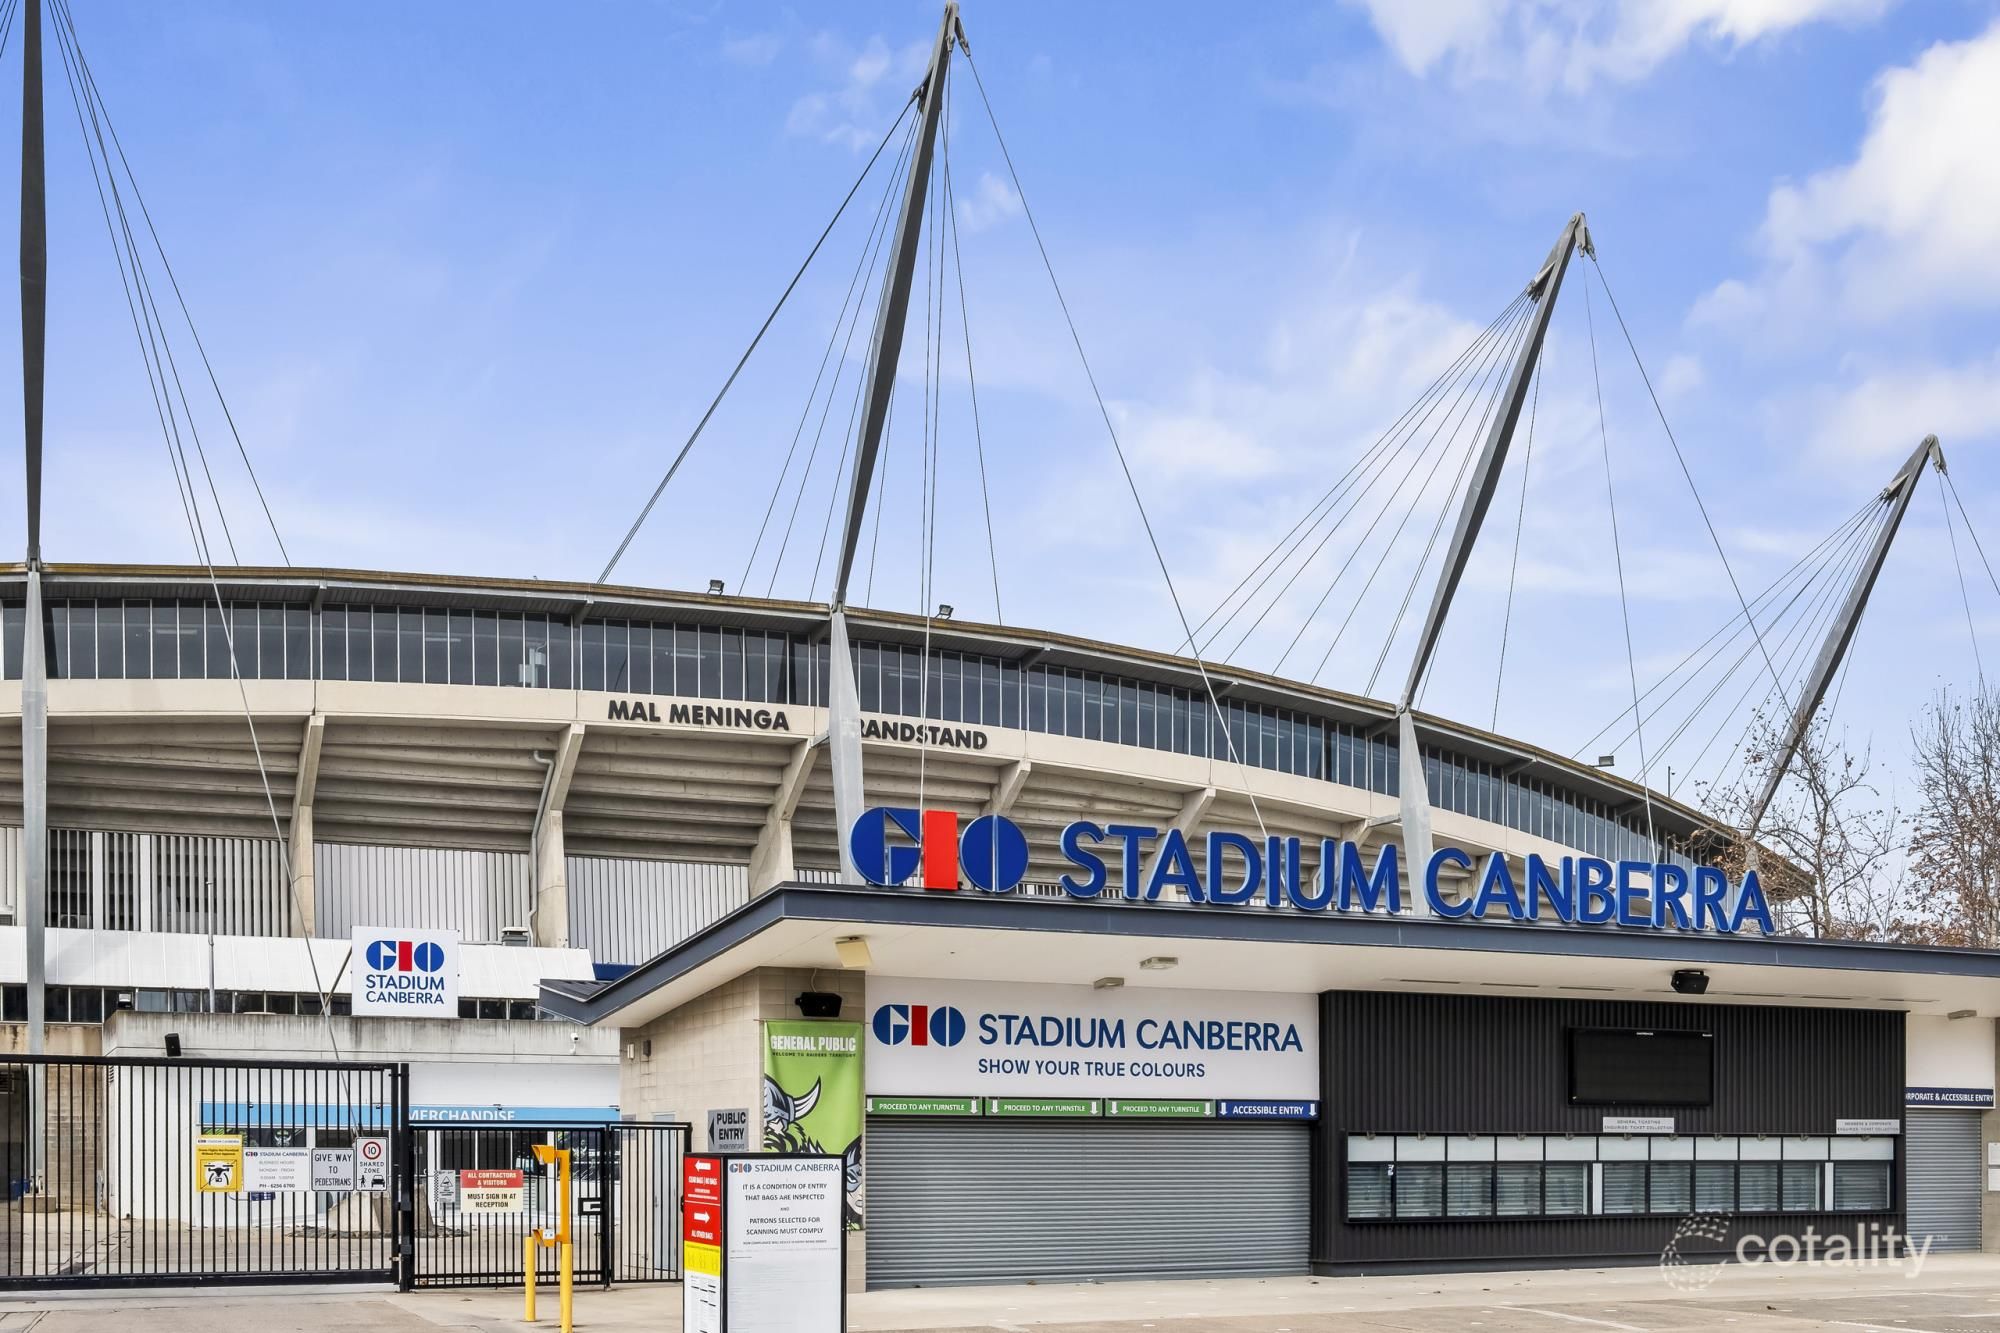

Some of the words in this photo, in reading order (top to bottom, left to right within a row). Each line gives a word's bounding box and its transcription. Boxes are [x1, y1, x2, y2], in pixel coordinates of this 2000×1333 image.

[607, 700, 661, 722] MAL
[669, 703, 790, 731] MENINGA
[849, 806, 1030, 893] GIO
[1058, 820, 1401, 915] STADIUM
[1425, 846, 1776, 936] CANBERRA
[366, 940, 445, 973] GIO
[366, 974, 445, 990] STADIUM
[366, 991, 445, 1005] CANBERRA
[872, 1004, 966, 1047] GIO
[978, 1013, 1126, 1049] STADIUM
[1136, 1018, 1303, 1052] CANBERRA
[770, 1035, 816, 1051] GENERAL
[818, 1037, 857, 1051] PUBLIC
[978, 1058, 1030, 1074] SHOW
[1035, 1060, 1080, 1076] YOUR
[1084, 1061, 1125, 1077] TRUE
[1130, 1062, 1206, 1078] COLOURS
[1935, 1092, 1940, 1101] &
[1941, 1093, 1975, 1102] ACCESSIBLE
[1976, 1094, 1994, 1102] ENTRY
[409, 1109, 516, 1120] MERCHANDISE
[1232, 1105, 1278, 1114] ACCESSIBLE
[1278, 1106, 1304, 1115] ENTRY
[716, 1111, 746, 1125] PUBLIC
[718, 1128, 745, 1140] ENTRY
[368, 1146, 376, 1155] 10
[315, 1153, 333, 1162] GIVE
[336, 1153, 352, 1161] WAY
[329, 1166, 338, 1174] TO
[729, 1163, 752, 1173] GIO
[755, 1164, 792, 1172] STADIUM
[795, 1163, 840, 1172] CANBERRA
[315, 1178, 352, 1186] PEDESTRIANS
